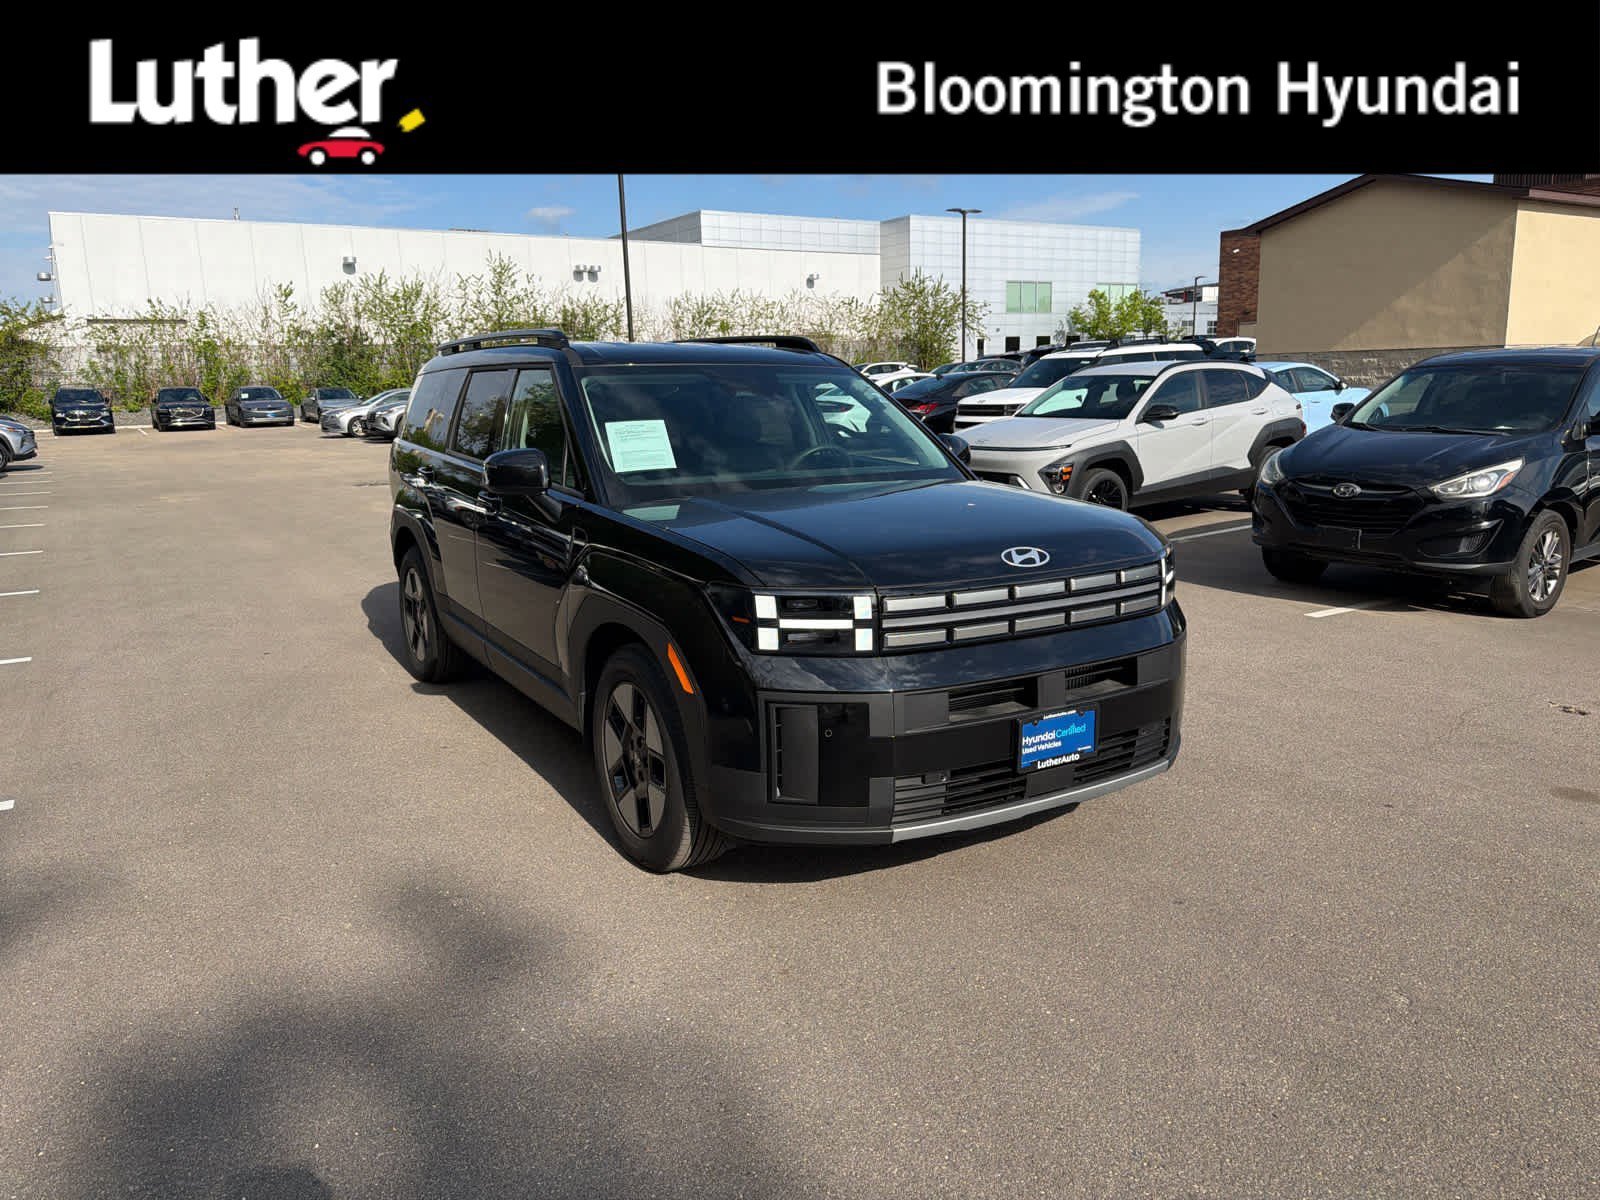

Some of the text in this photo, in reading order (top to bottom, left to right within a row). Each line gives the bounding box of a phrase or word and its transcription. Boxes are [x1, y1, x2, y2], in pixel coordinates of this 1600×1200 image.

[1022, 723, 1086, 746] Hyundai Certified
[1022, 740, 1062, 754] Used Vehicles
[1037, 753, 1080, 769] LutherAuto
